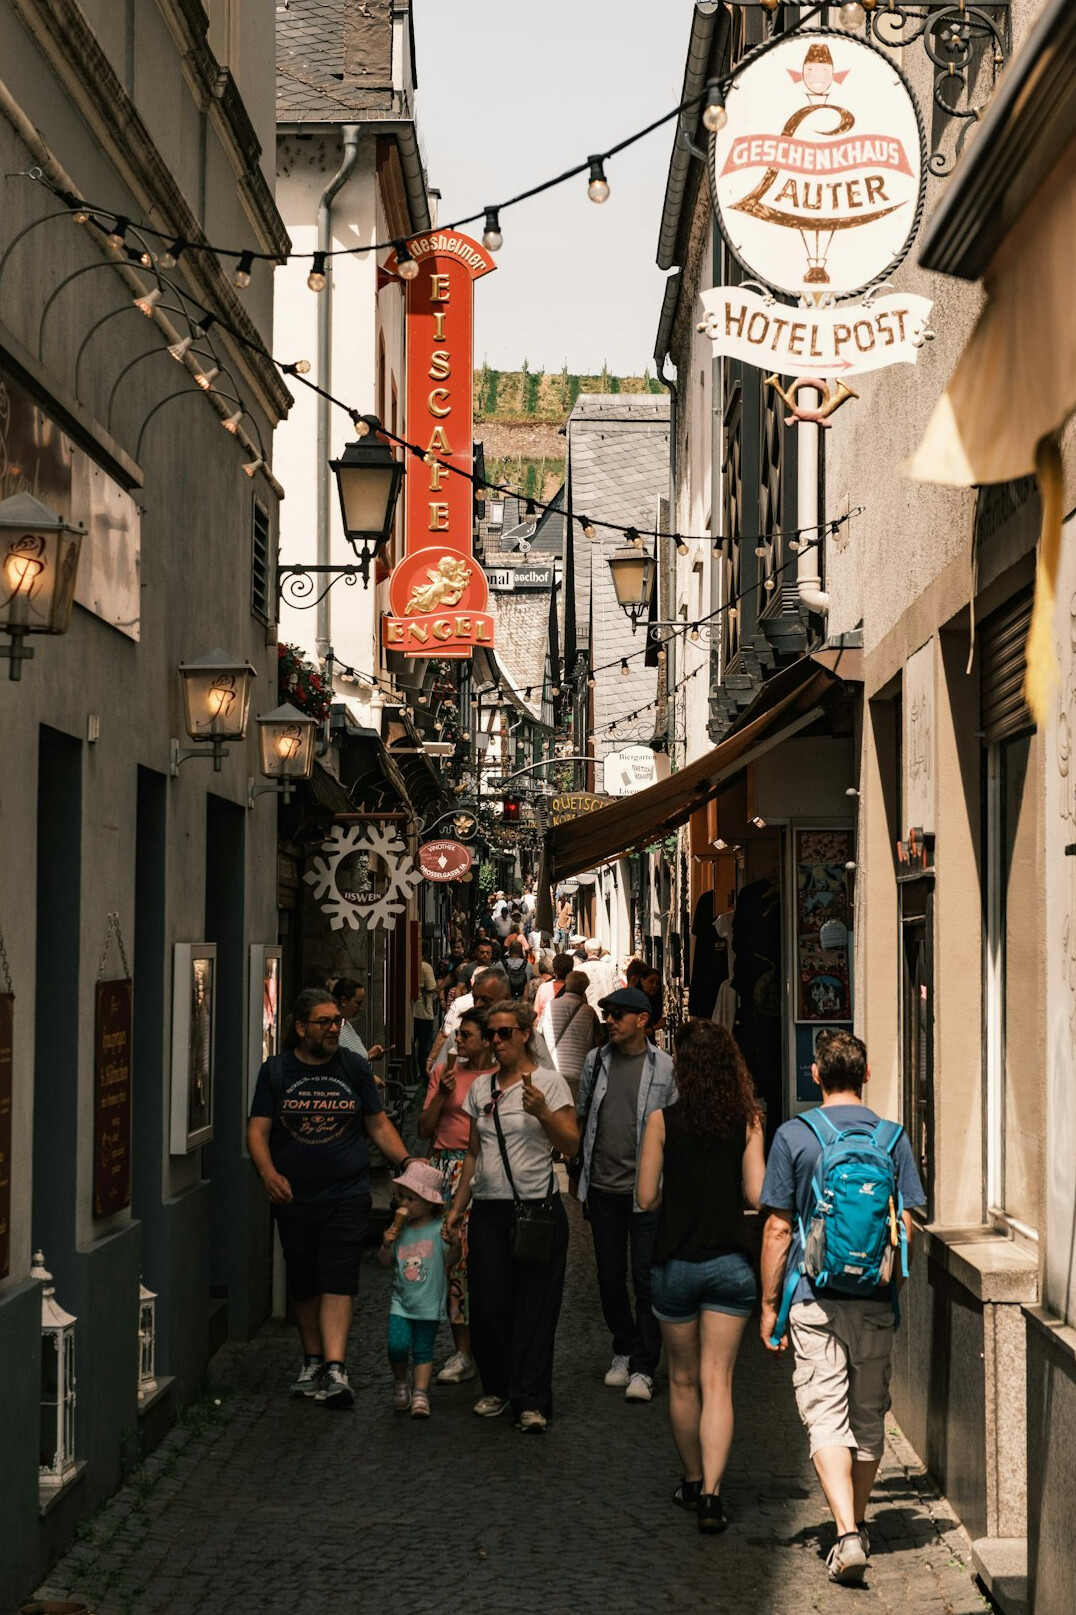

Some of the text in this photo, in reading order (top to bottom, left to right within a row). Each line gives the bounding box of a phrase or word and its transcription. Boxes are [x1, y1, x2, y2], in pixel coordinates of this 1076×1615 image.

[733, 140, 899, 170] GESCHENKHAUS
[394, 234, 487, 271] desheimer
[725, 302, 910, 357] HOTEL POST
[387, 616, 491, 644] ENGEL
[619, 753, 657, 762] Biergarten
[427, 843, 457, 852] VINOTHEK
[420, 864, 461, 878] DROSSELGASSE
[344, 892, 382, 902] EISWEIN
[282, 1100, 356, 1110] TOM TAILOR
